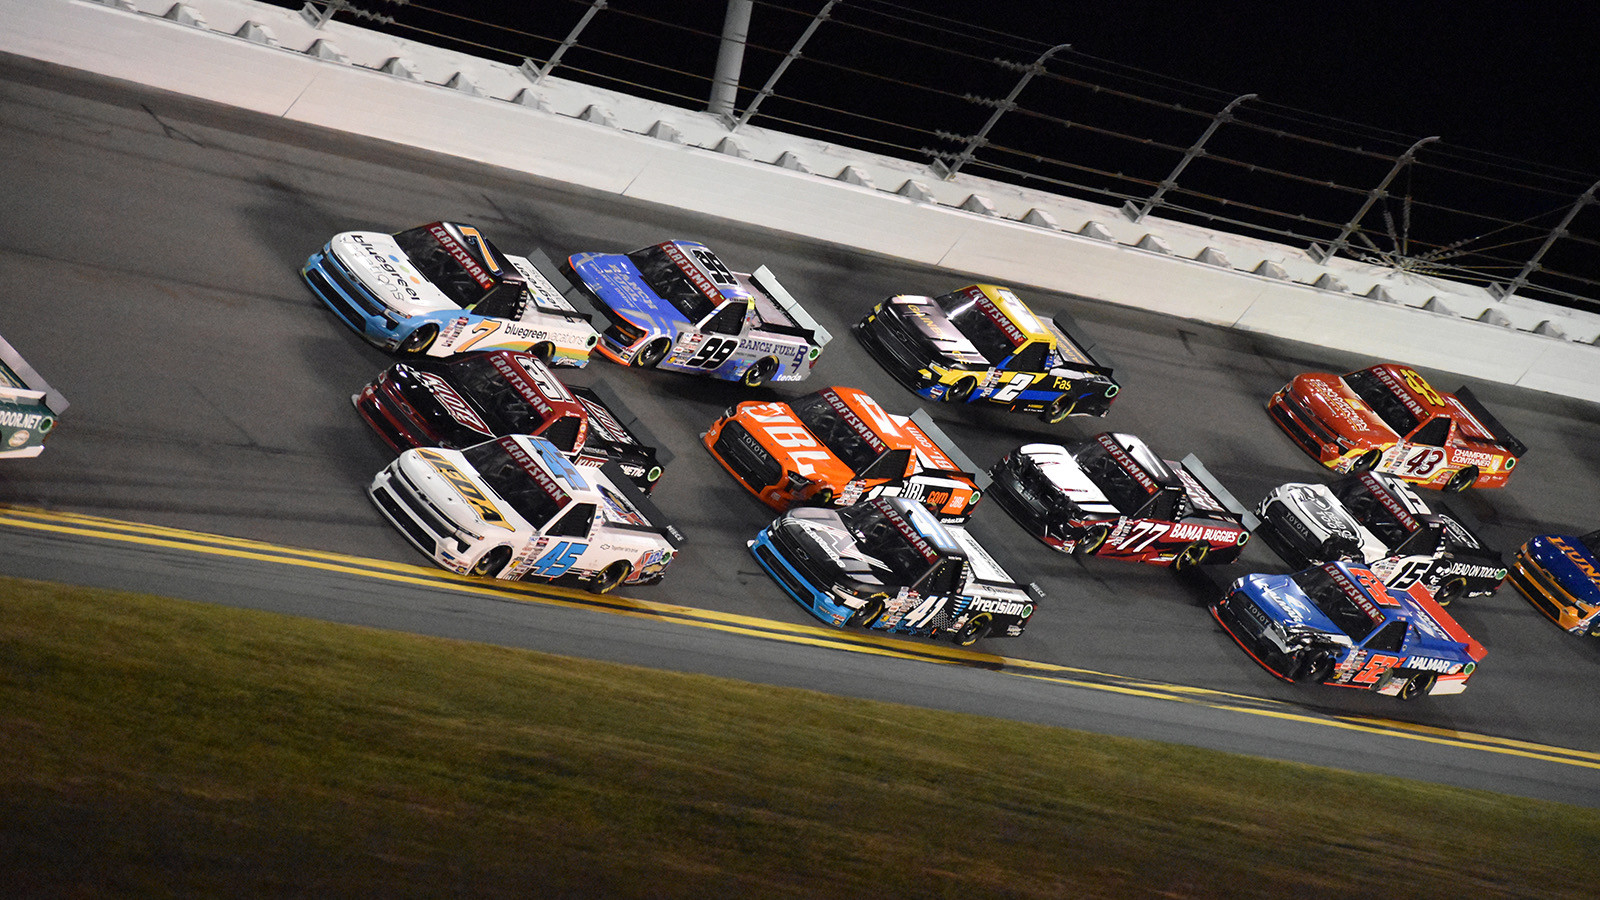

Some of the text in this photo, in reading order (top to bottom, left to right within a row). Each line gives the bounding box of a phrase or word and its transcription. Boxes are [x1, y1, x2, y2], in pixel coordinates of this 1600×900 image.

[430, 225, 489, 283] CRAFTSMAN
[690, 249, 739, 287] 99
[662, 243, 718, 299] CRAFTSMAN
[969, 288, 1022, 341] CRAFTSMAN
[454, 318, 502, 353] 7
[504, 323, 548, 340] bluegreen
[739, 339, 796, 356] RANCH FUEL
[684, 335, 740, 371] 99
[489, 355, 551, 414] CRAFTSMAN
[992, 372, 1036, 402] 2
[1372, 366, 1423, 415] CRAFTSMAN
[823, 391, 881, 450] CRAFTSMAN
[742, 433, 768, 460] TOYOTA
[1097, 435, 1152, 489] CRAFTSMAN
[1404, 447, 1444, 476] 43
[1451, 455, 1491, 467] CONTAINER
[1454, 449, 1494, 461] CHAMPION
[501, 439, 565, 501] CRAFTSMAN
[1360, 475, 1413, 527] CRAFTSMAN
[876, 499, 933, 558] CRAFTSMAN
[1116, 521, 1171, 553] 77
[1169, 523, 1238, 543] BAMA BUGGIES
[1285, 511, 1310, 538] TOYOTA
[531, 541, 590, 578] 45
[1386, 560, 1432, 591] 15
[1450, 562, 1498, 579] DEAD ON TOOLS
[968, 595, 1025, 616] Precision
[1324, 564, 1379, 618] CRAFTSMAN
[903, 595, 949, 628] 41
[1352, 653, 1399, 684] 52
[1406, 655, 1451, 674] HALMAR
